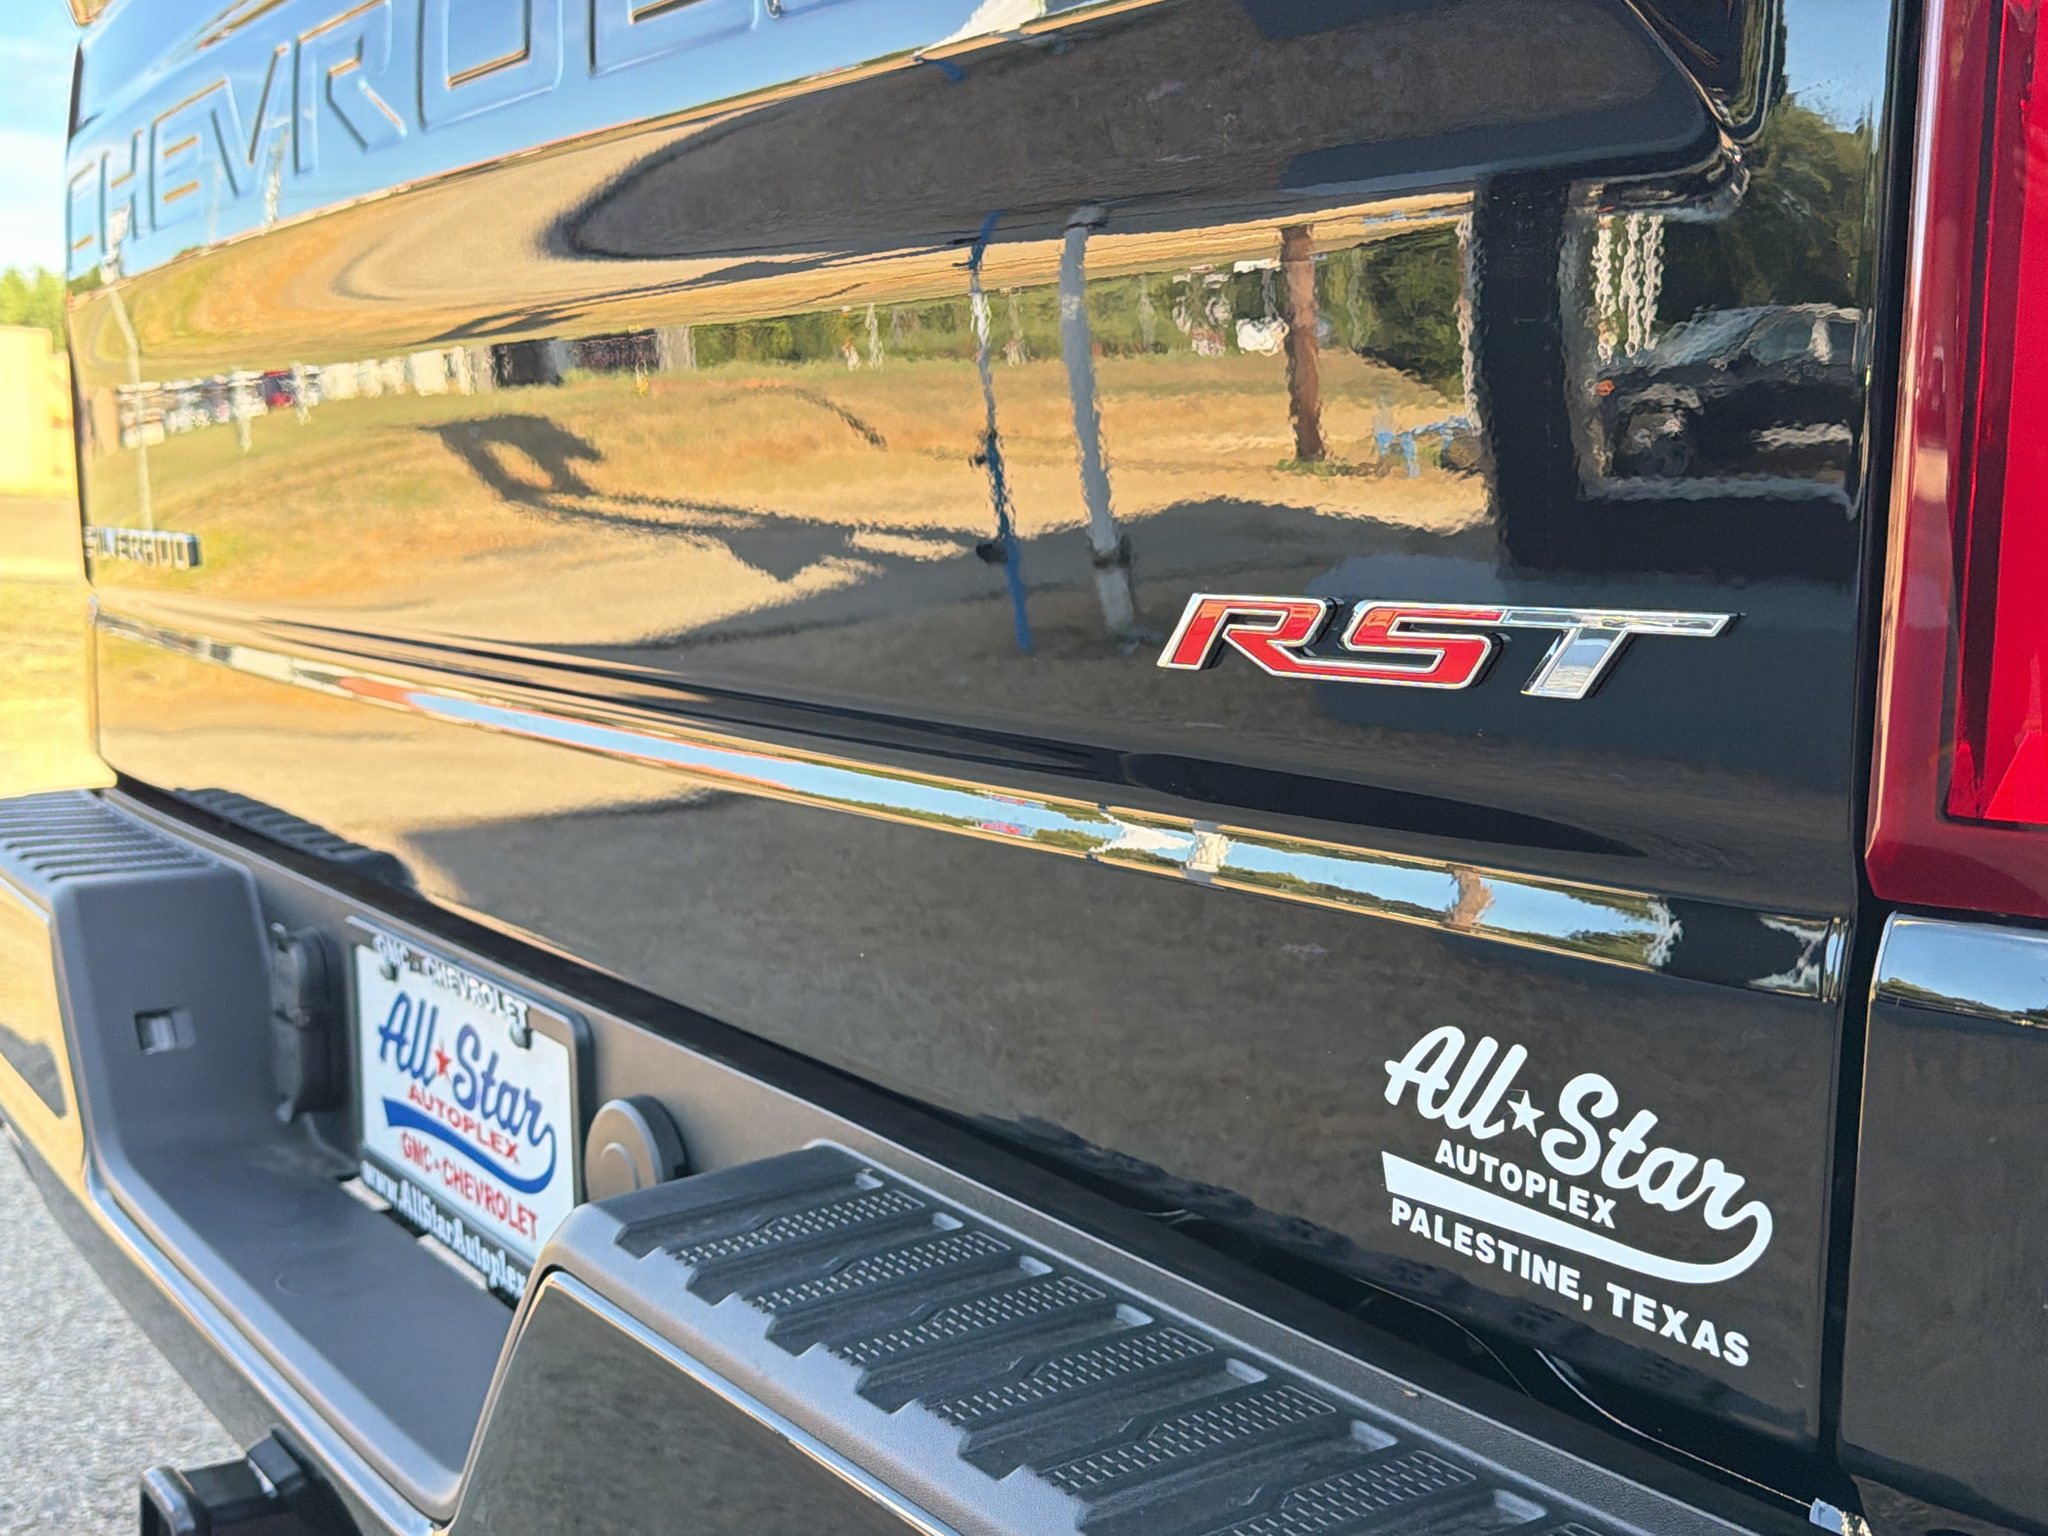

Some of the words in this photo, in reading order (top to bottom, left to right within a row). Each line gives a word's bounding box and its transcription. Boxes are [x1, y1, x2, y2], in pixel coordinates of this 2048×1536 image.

[1157, 593, 1736, 699] RST
[378, 989, 439, 1087] All
[453, 1023, 554, 1147] Star
[408, 1083, 520, 1166] AUTOPLEX
[1384, 1025, 1528, 1140] All
[1540, 1073, 1768, 1230] Star
[1435, 1139, 1616, 1229] AUTOPLEX
[1391, 1197, 1593, 1311] PALESTINE,
[1606, 1282, 1750, 1367] TEXAS
